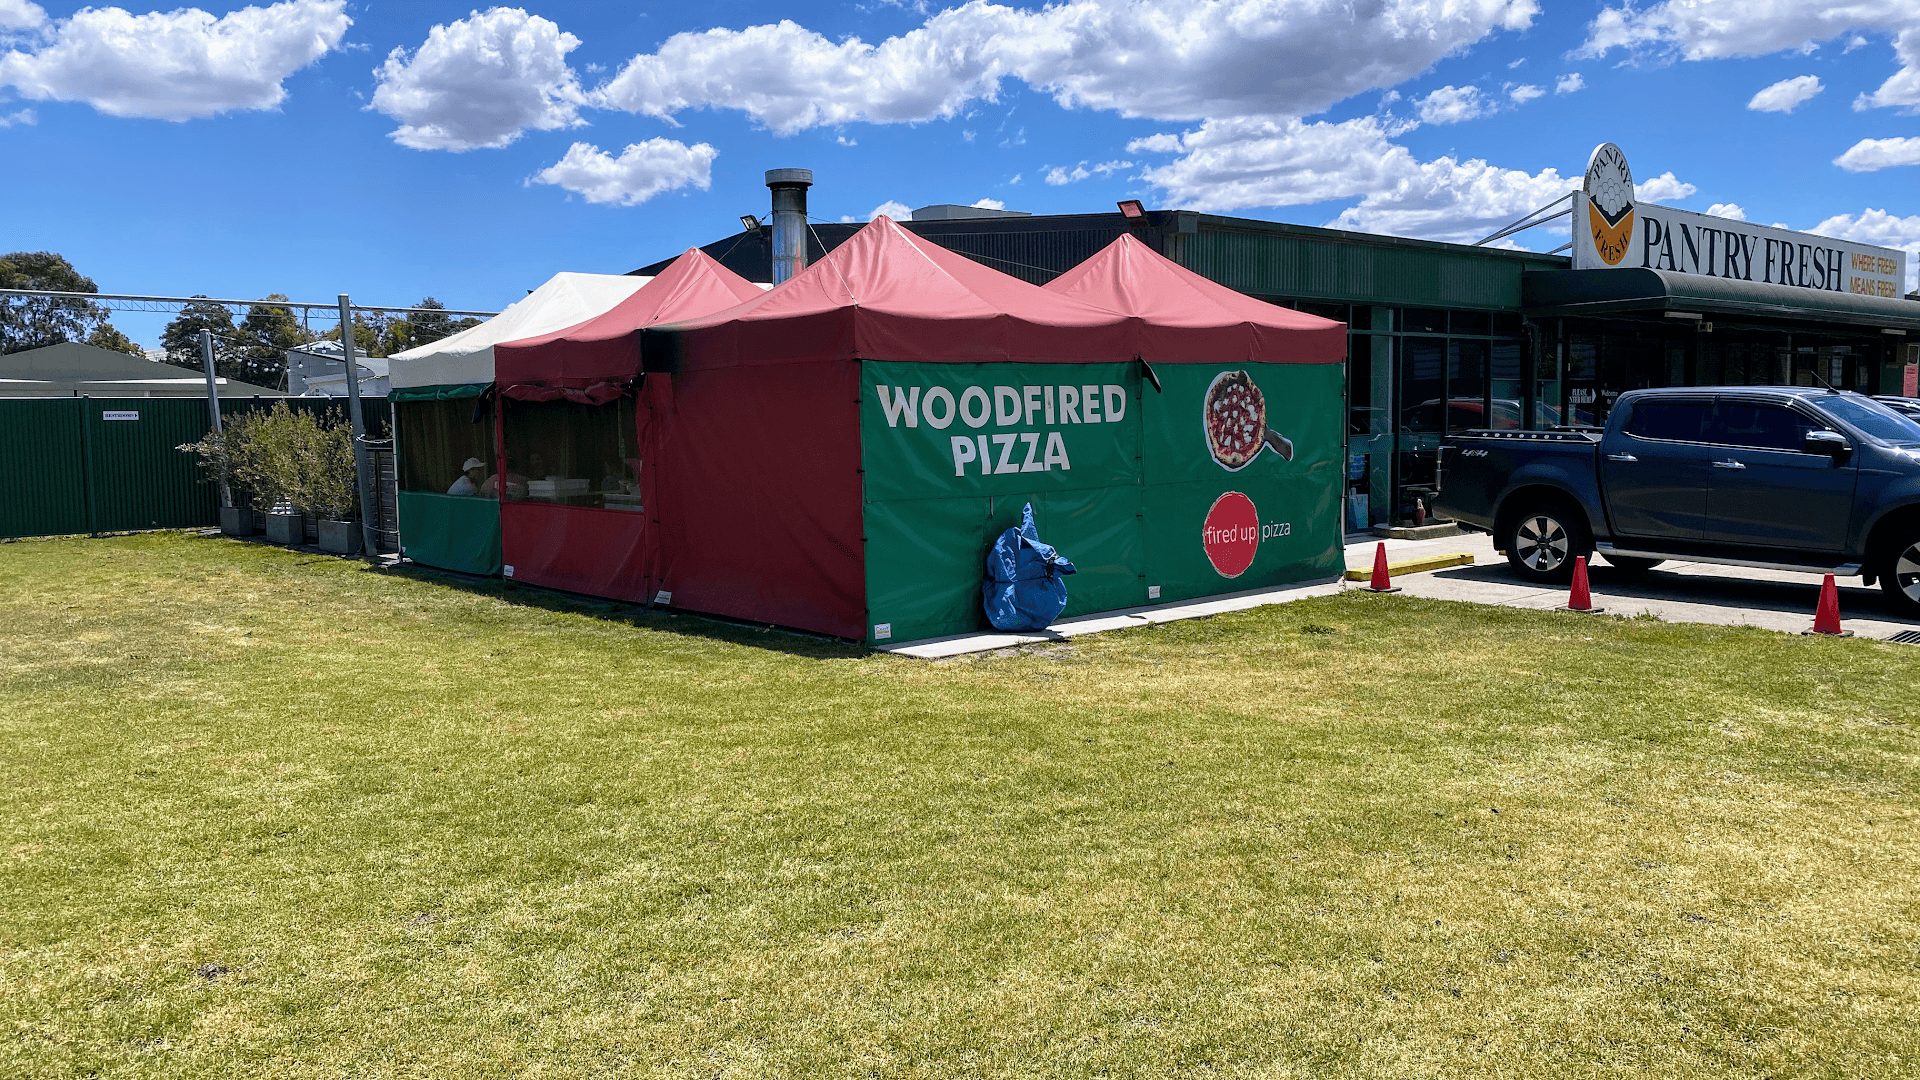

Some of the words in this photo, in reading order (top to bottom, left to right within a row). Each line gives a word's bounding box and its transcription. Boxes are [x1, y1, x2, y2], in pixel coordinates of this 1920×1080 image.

[1594, 148, 1631, 184] PANTRY
[1595, 229, 1629, 261] FRESH
[1641, 216, 1758, 281] PANTRY
[1764, 237, 1844, 292] FRESH
[1851, 252, 1875, 273] WHERE
[1877, 256, 1898, 276] FRESH
[1850, 276, 1875, 296] MEANS
[1877, 280, 1897, 298] FRESH
[876, 384, 1127, 430] WOODFIRED
[950, 431, 1071, 477] PIZZA
[1206, 523, 1237, 545] fired
[1240, 525, 1257, 545] up
[1262, 520, 1291, 543] pizza
